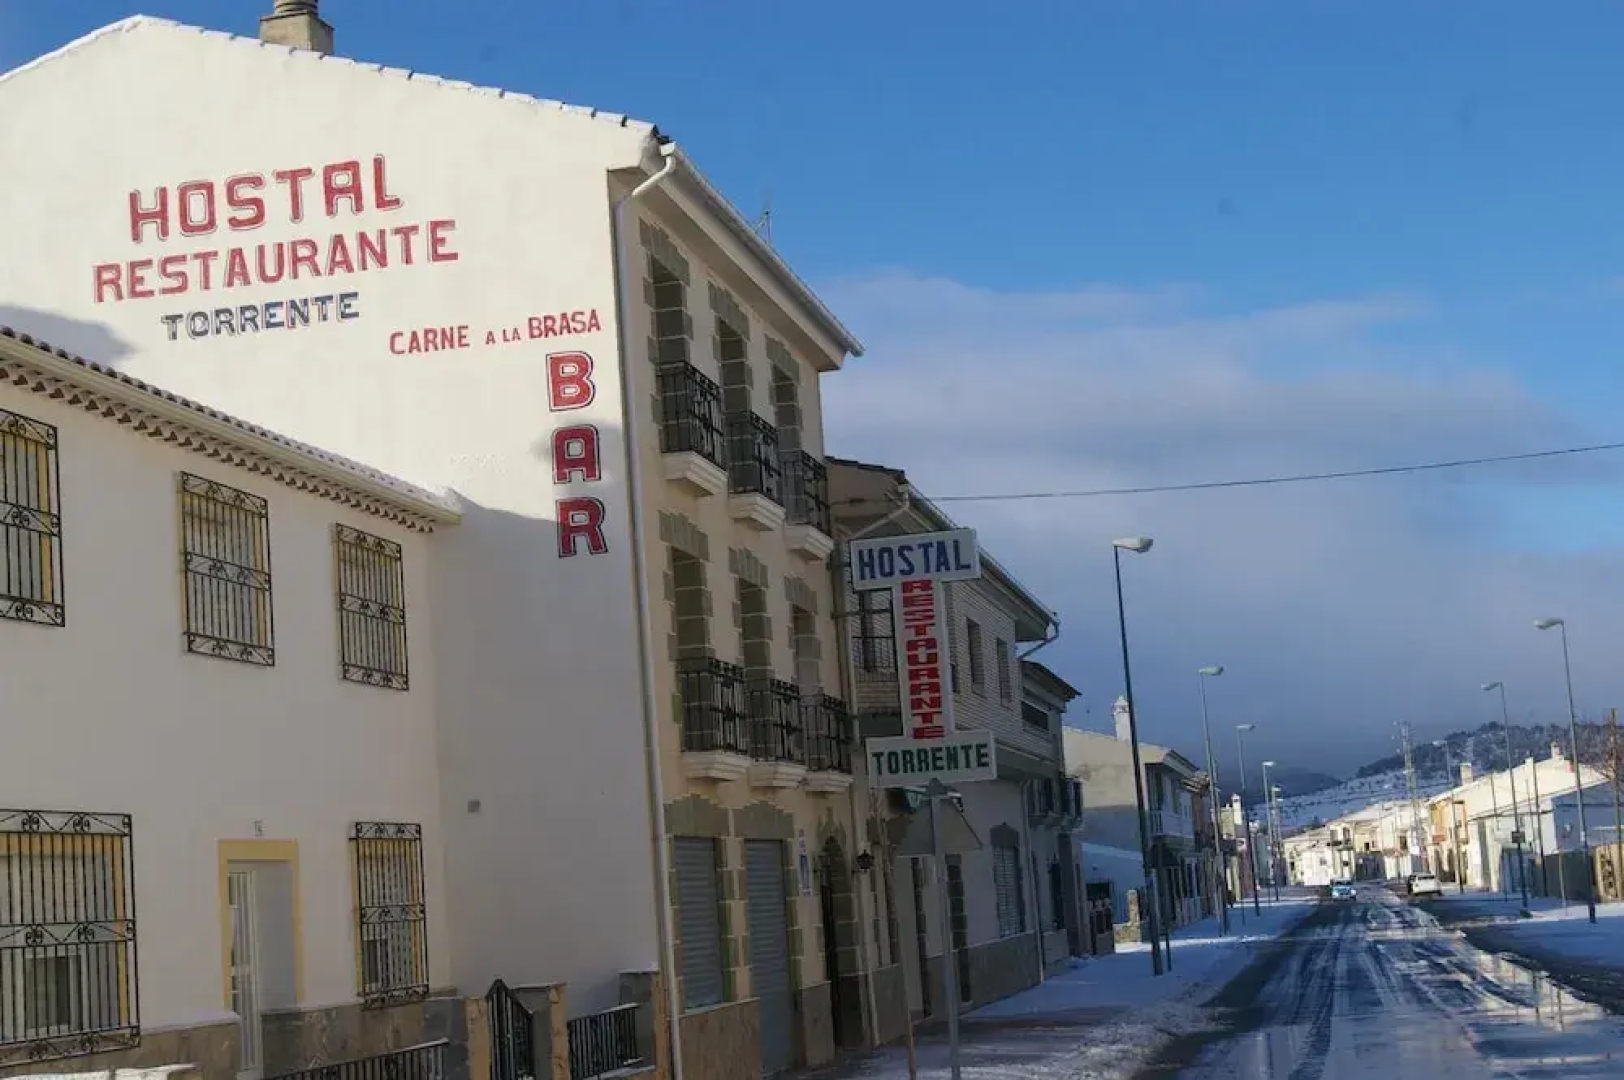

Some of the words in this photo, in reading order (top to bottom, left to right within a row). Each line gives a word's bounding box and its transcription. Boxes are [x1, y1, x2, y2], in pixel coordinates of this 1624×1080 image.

[128, 154, 404, 243] HOSTAL
[94, 220, 459, 302] RESTAURANTE
[162, 292, 360, 341] TORRENTE
[389, 325, 470, 355] CARNE
[485, 330, 496, 345] A
[502, 328, 521, 343] LA
[528, 308, 602, 340] BRASA
[545, 350, 609, 559] BAR
[858, 538, 972, 580] HOSTAL
[902, 579, 945, 740] RESTAURANTE
[872, 744, 990, 776] TORRENTE
